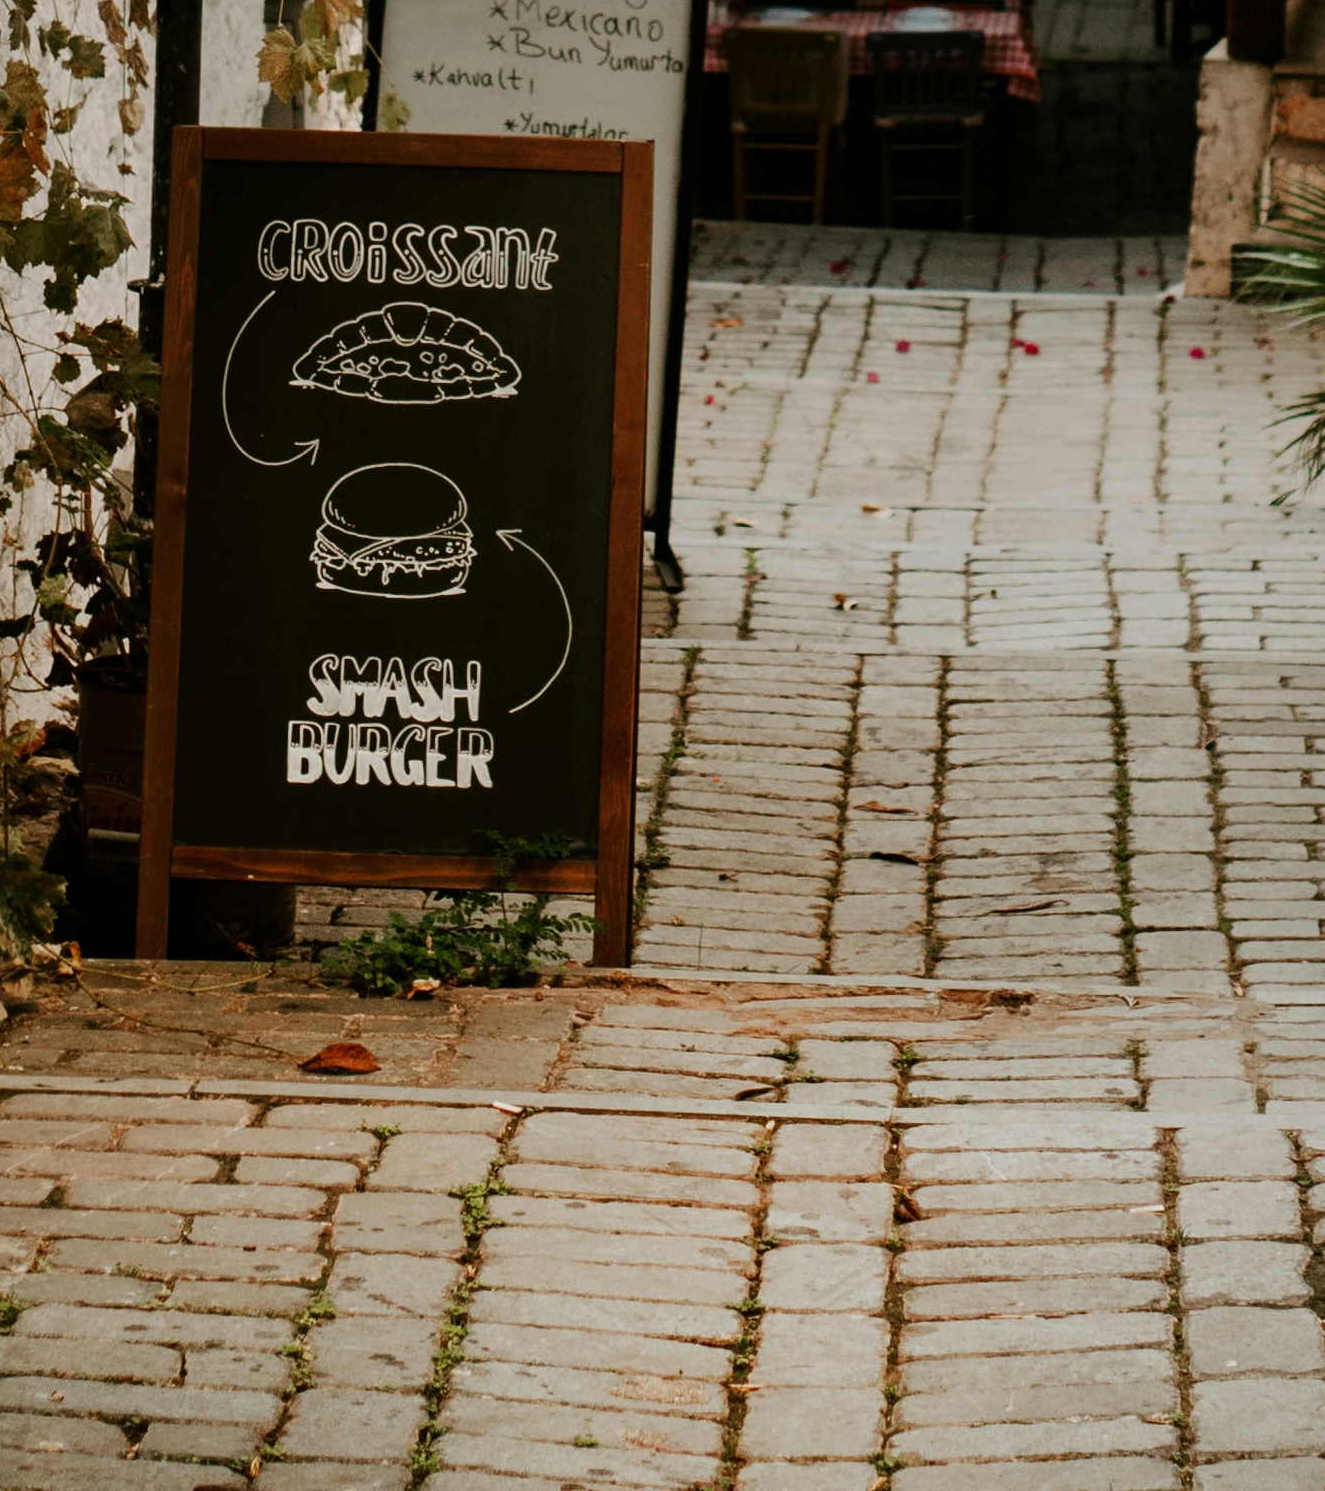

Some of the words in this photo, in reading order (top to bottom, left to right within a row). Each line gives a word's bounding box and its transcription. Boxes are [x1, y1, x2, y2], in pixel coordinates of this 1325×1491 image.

[512, 28, 582, 64] Bun
[588, 37, 685, 75] Yumurta
[306, 653, 482, 722] SMASH
[286, 720, 495, 789] BURGER
